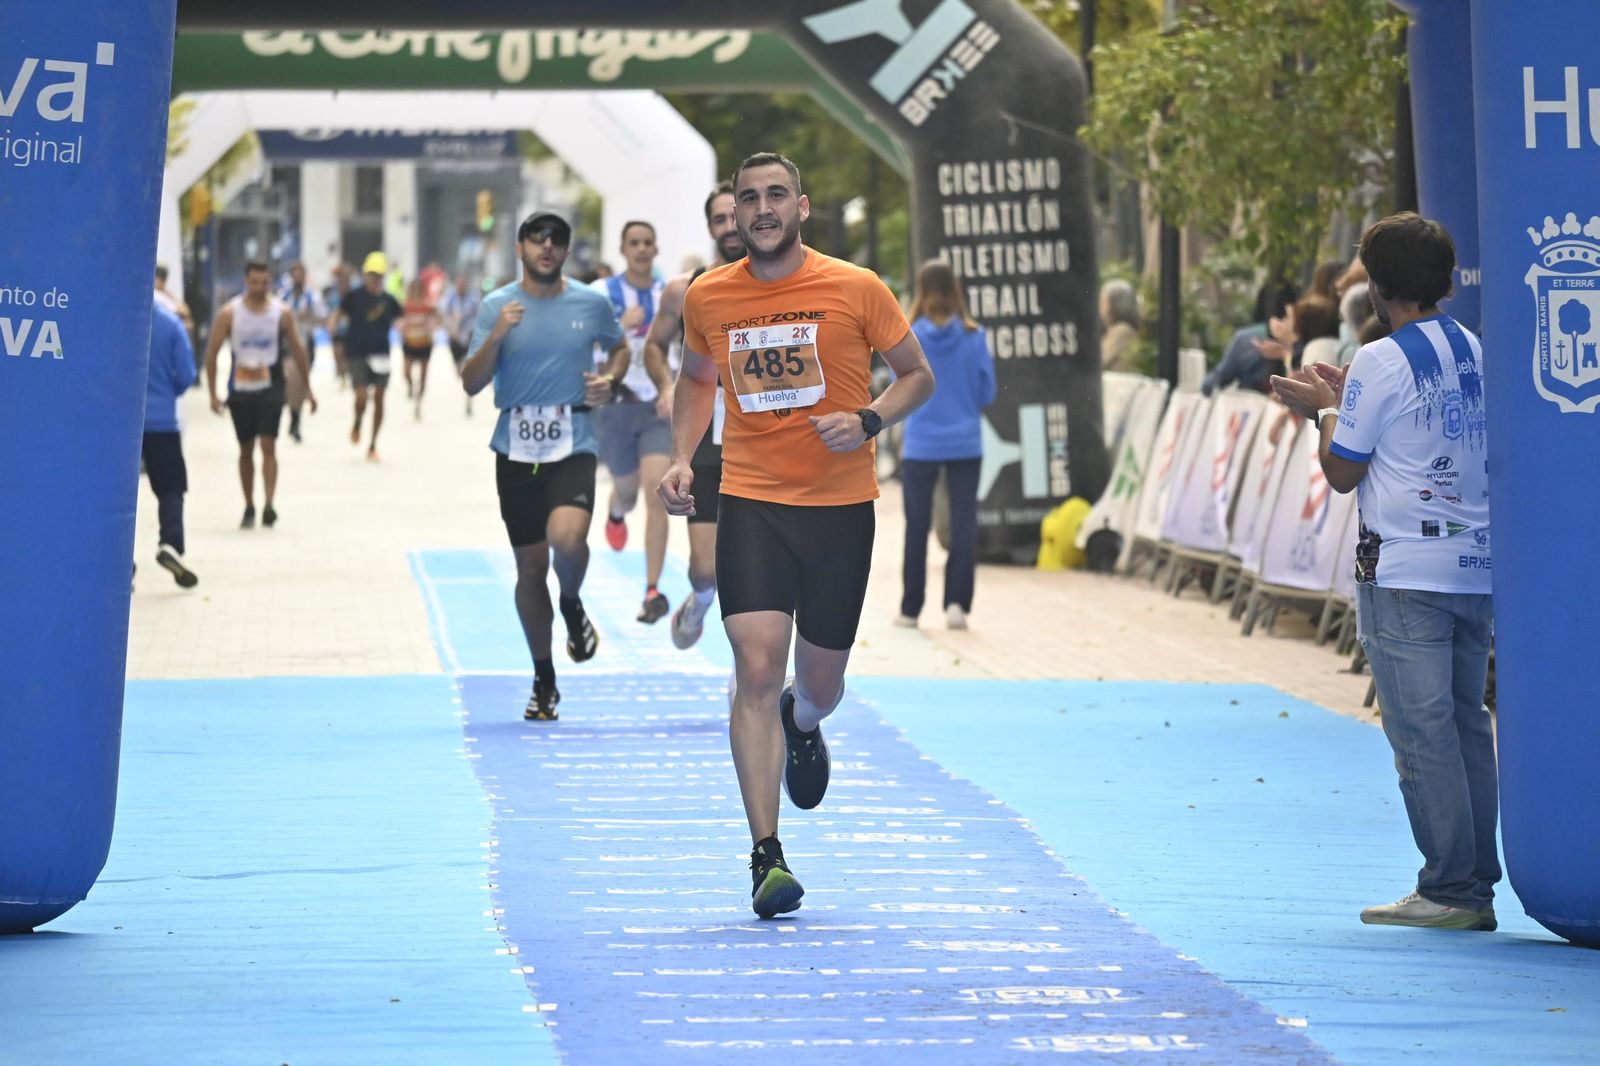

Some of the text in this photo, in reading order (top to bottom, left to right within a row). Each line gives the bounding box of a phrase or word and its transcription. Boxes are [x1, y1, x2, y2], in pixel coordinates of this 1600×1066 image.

[1522, 66, 1600, 149] H
[938, 157, 1061, 197] CICLISMO
[943, 194, 1060, 237] TRIATLÓN
[1460, 268, 1481, 286] DI
[1553, 279, 1563, 288] ET
[43, 286, 69, 309] de
[967, 283, 1042, 318] TRAIL
[1539, 296, 1547, 327] MARIS
[734, 326, 811, 345] 2K 2K
[1540, 332, 1549, 370] PORTUS
[743, 347, 805, 379] 485
[758, 390, 799, 404] Huelva
[519, 420, 561, 442] 886
